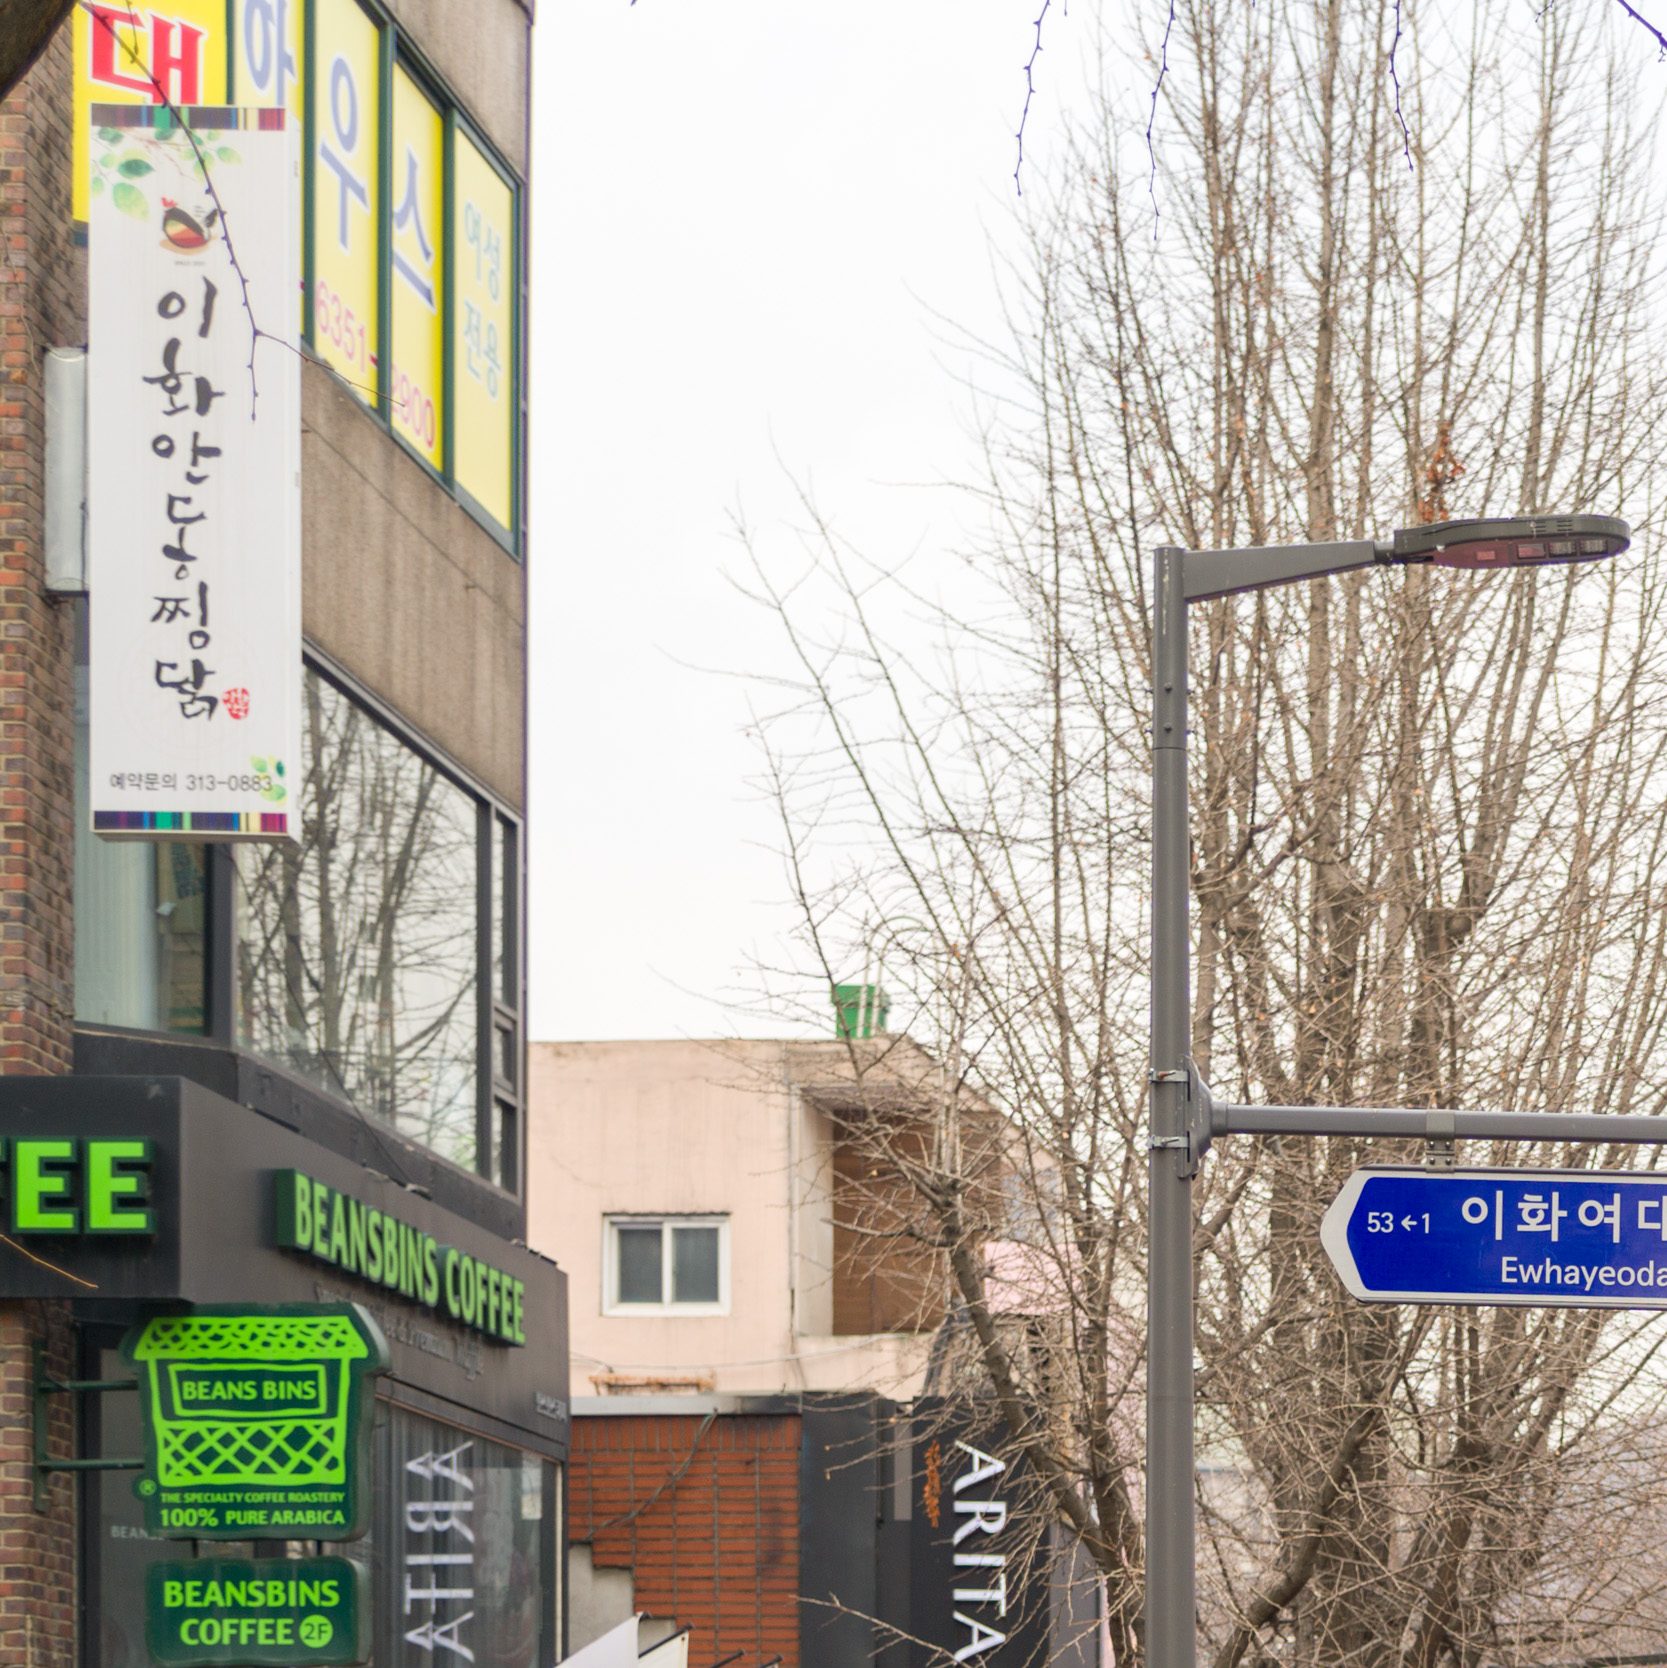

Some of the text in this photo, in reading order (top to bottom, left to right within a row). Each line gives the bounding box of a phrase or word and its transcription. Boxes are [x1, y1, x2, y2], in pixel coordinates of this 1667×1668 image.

[109, 772, 274, 792] 예약문의 313-0883
[0, 1138, 152, 1233] EE
[1366, 1211, 1395, 1234] 53
[294, 1171, 526, 1347] BEANSBINS COFFEE
[182, 1380, 317, 1400] BEANS BINS
[160, 1492, 346, 1504] THE SPECIALTY COFFEE ROASTERY
[160, 1507, 346, 1528] 100% PURE ARABICA
[163, 1579, 341, 1608] BEANSBINS
[179, 1617, 329, 1646] COFFEE 2F
